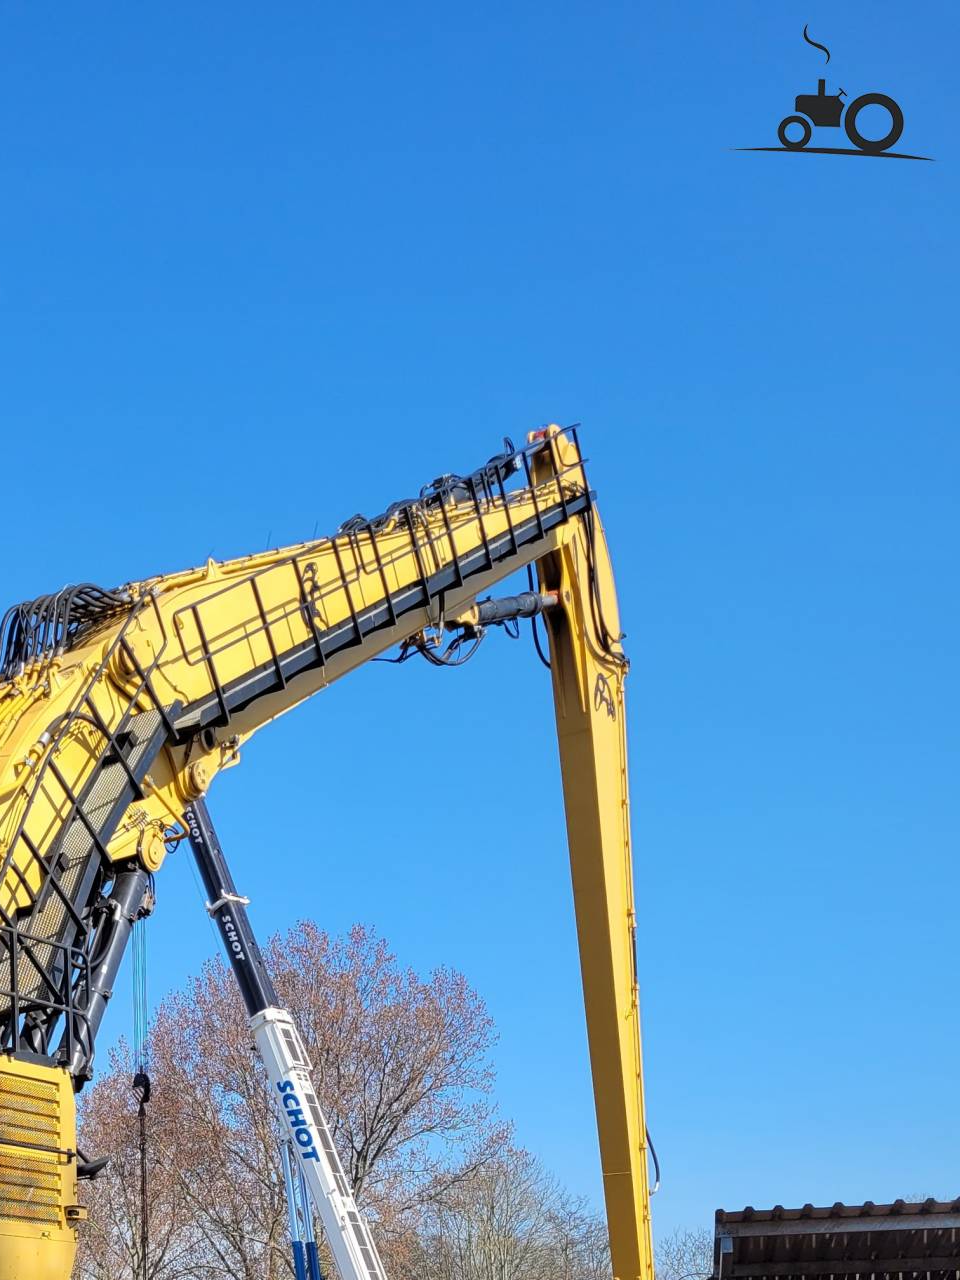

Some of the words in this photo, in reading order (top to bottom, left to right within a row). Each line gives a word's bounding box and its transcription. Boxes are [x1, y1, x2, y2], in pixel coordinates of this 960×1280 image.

[185, 806, 204, 844] SCHOT
[222, 915, 245, 961] SCHOT
[276, 1080, 321, 1162] SCHOT
